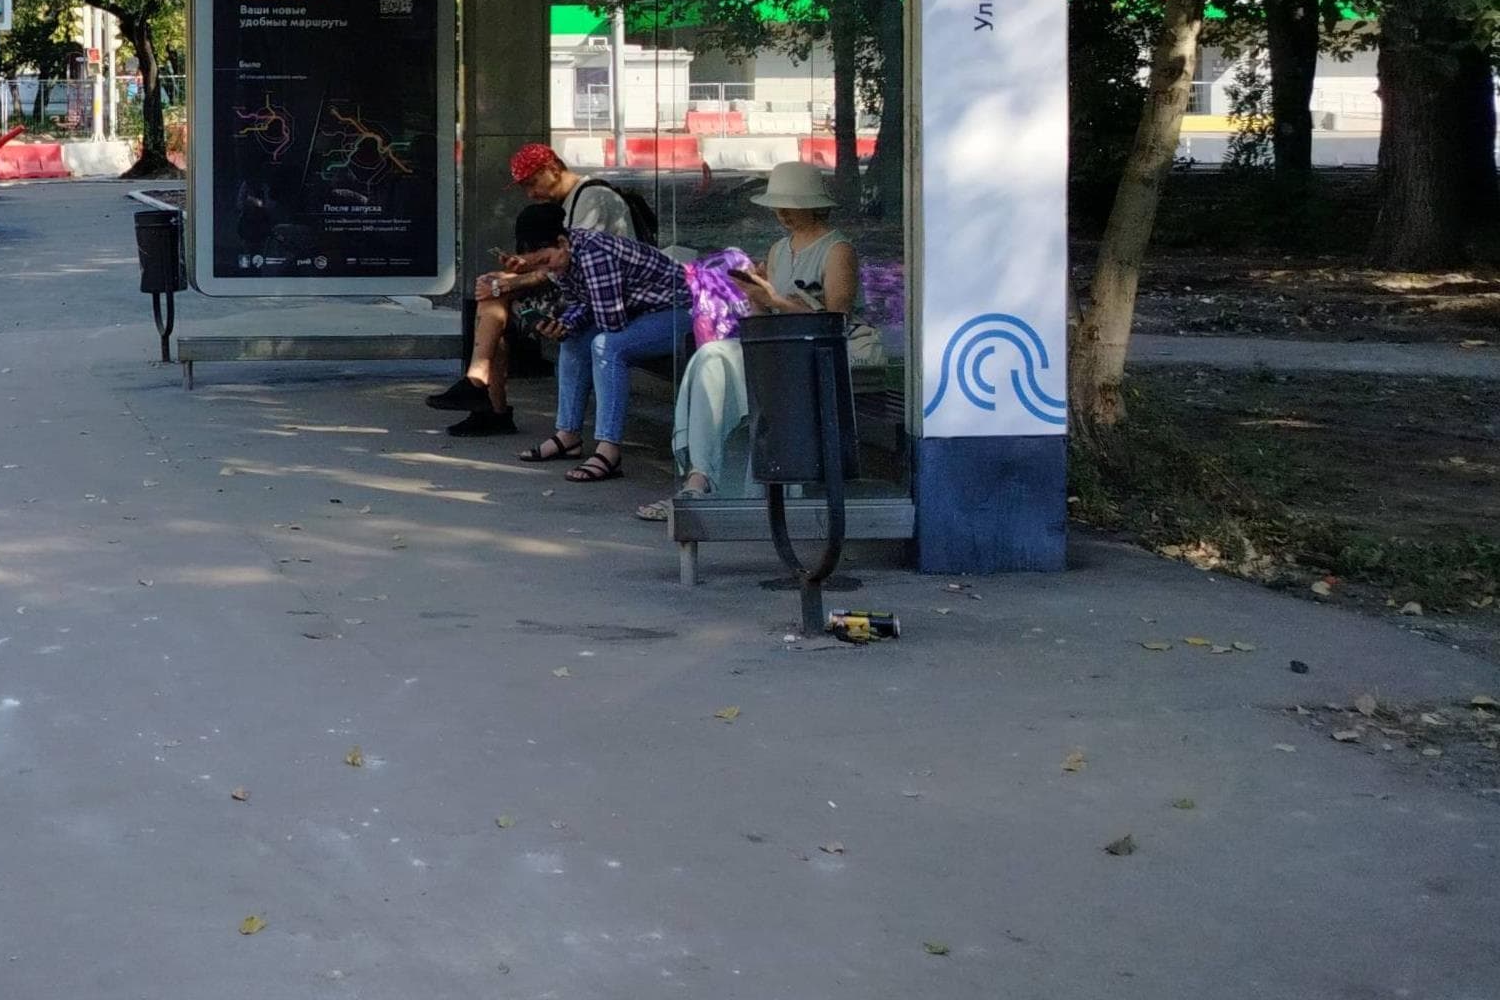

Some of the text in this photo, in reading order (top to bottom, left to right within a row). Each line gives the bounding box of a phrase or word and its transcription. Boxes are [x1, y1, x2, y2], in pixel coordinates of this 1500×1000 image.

[239, 4, 307, 15] Ваши новые
[239, 17, 348, 29] удобные маршруты
